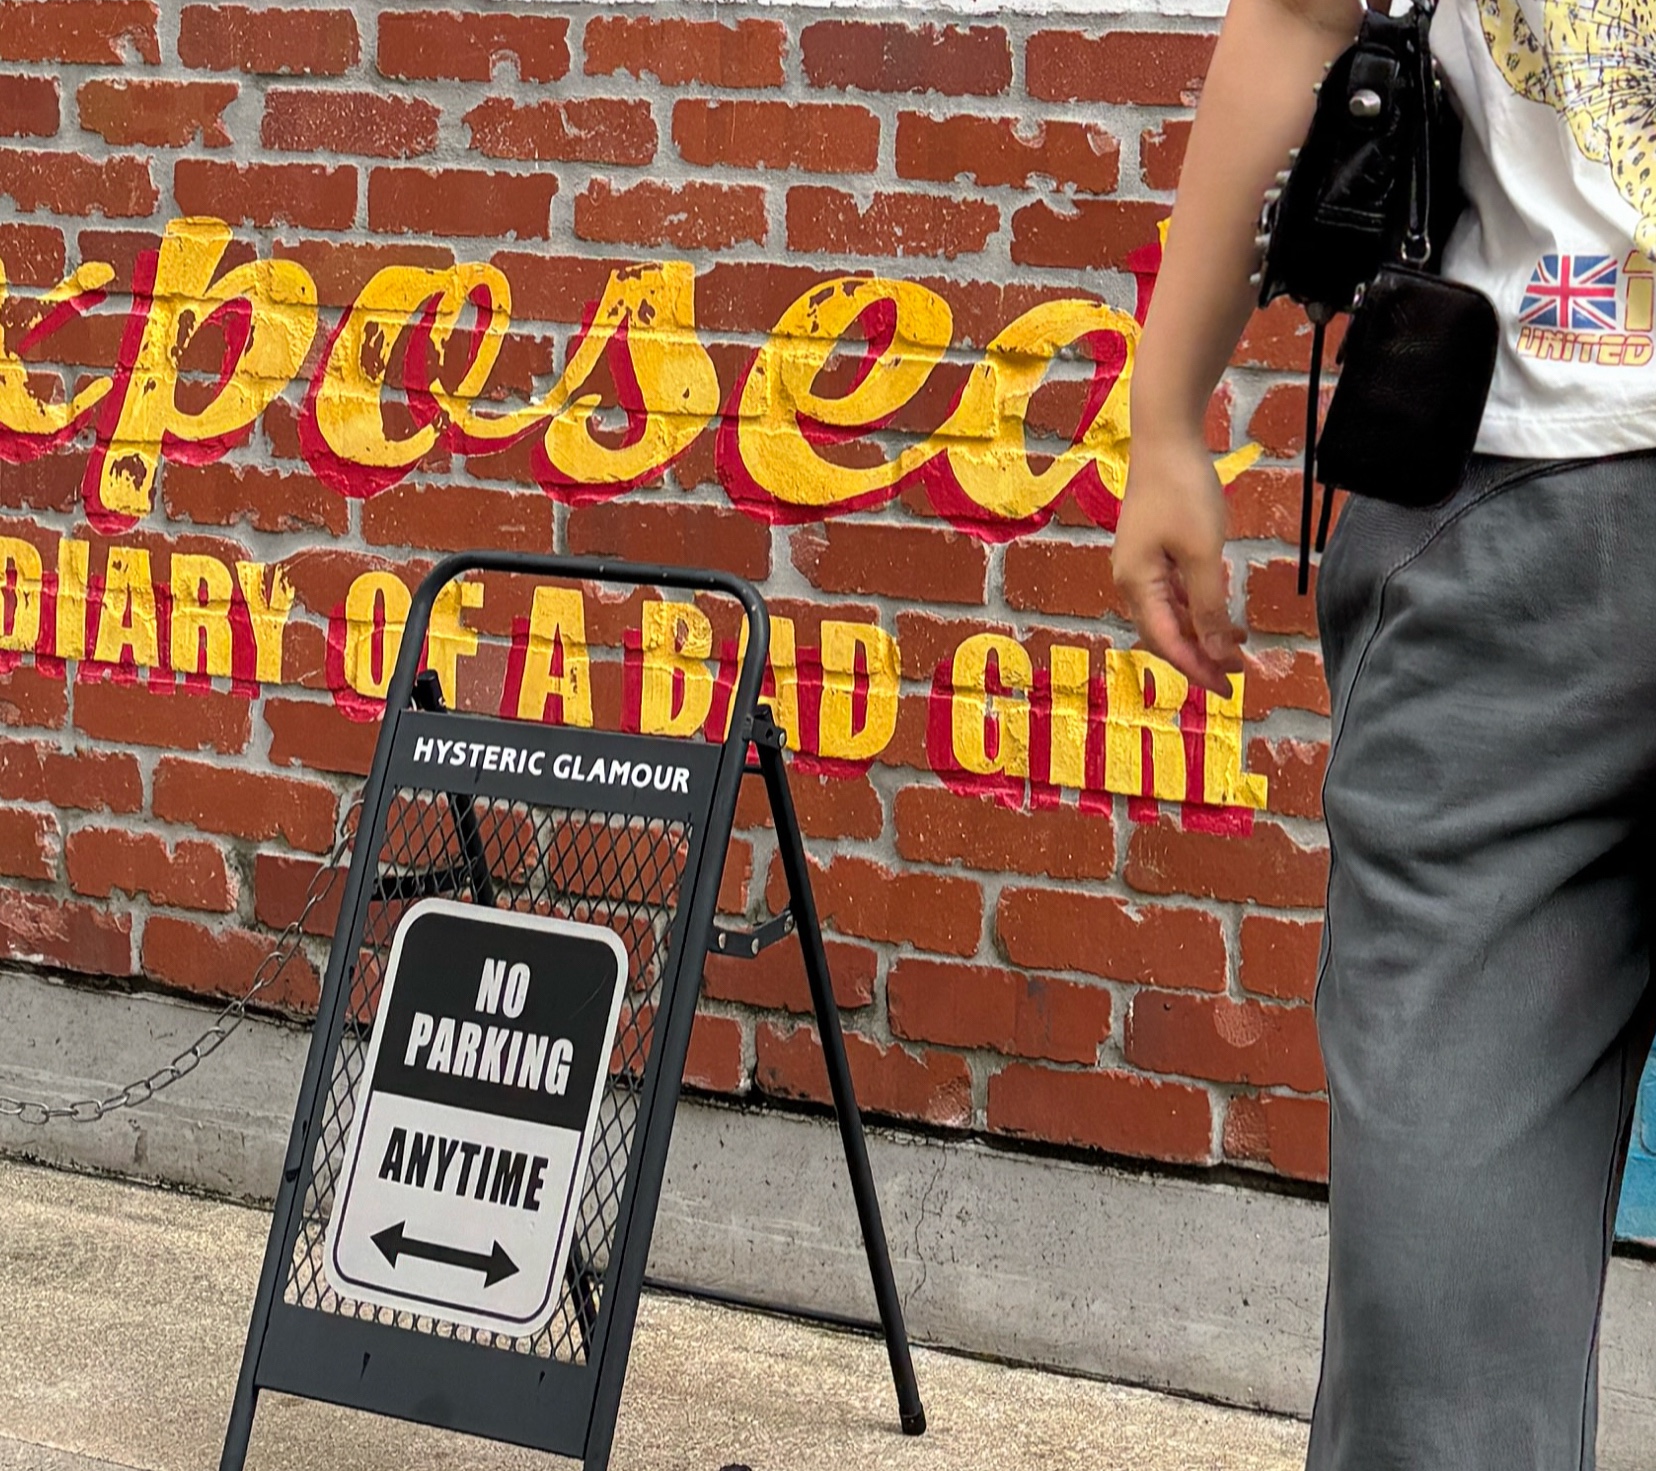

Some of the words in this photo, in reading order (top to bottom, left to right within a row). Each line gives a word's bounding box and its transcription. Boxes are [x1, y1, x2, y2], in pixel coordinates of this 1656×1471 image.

[1517, 327, 1655, 367] UNITED
[0, 536, 297, 685] DIARY
[343, 571, 486, 712] OF
[516, 585, 595, 729] A
[639, 599, 902, 761] BAD
[951, 631, 1269, 804] GIRL
[413, 736, 544, 777] HYSTERIC
[552, 753, 690, 794] GLAMOUR
[474, 957, 531, 1019] NO
[403, 1011, 575, 1096] PARKING
[378, 1126, 549, 1212] ANYTIME
